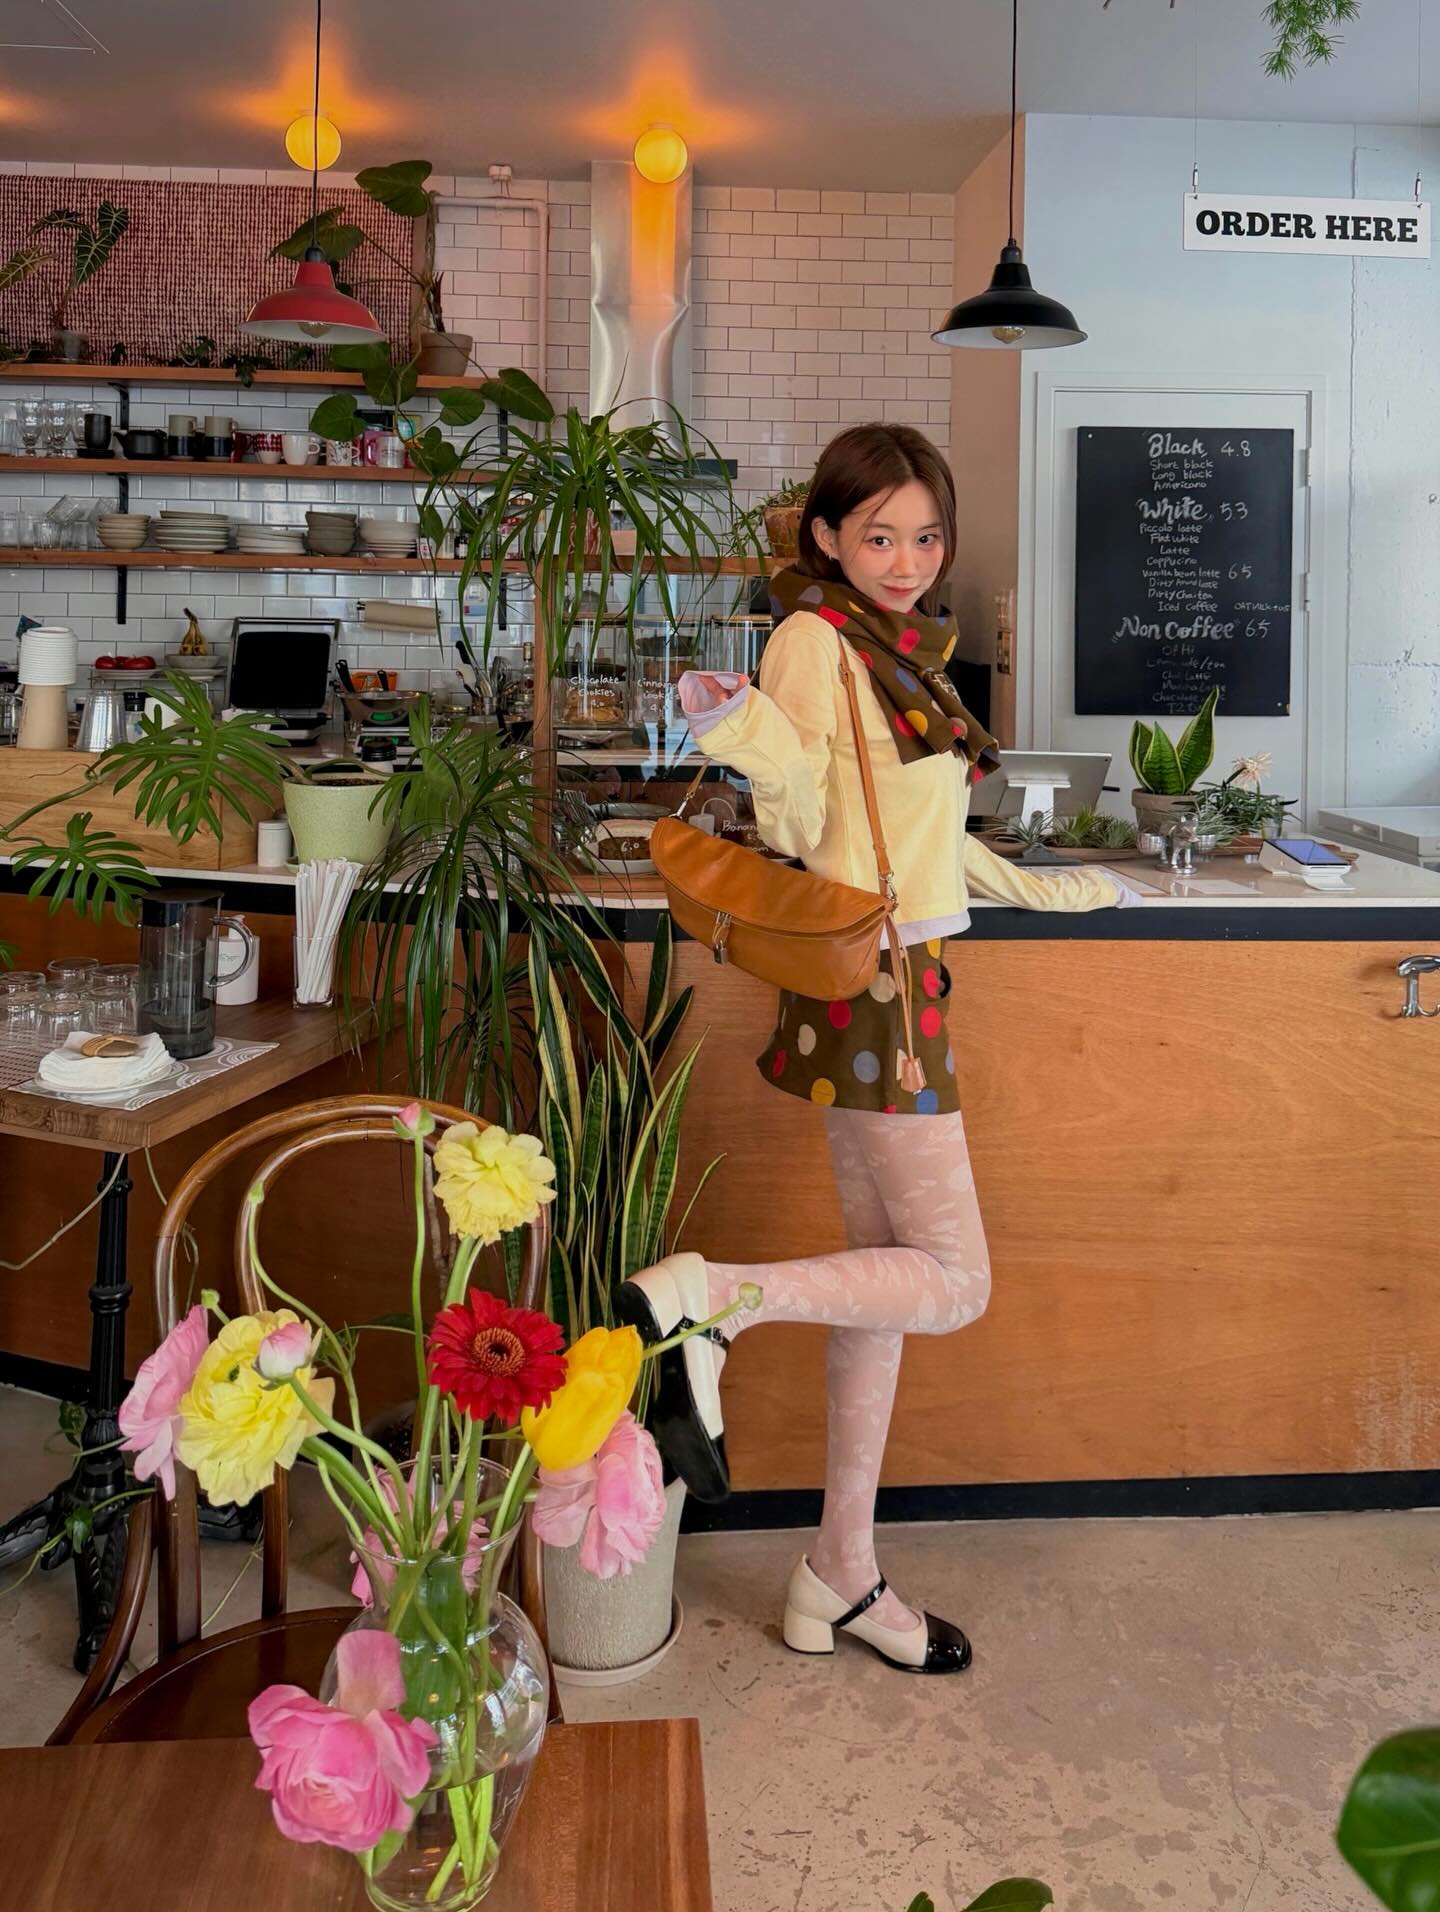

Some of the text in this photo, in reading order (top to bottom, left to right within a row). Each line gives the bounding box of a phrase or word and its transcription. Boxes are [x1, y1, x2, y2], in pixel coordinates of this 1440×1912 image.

[1195, 209, 1418, 243] ORDER HERE
[1220, 440, 1251, 457] 4.8
[1150, 458, 1214, 470] Short black
[1151, 469, 1213, 482] Long black
[1154, 481, 1207, 491] Americano
[1160, 545, 1191, 555] Latte
[569, 674, 620, 686] Chocolate
[637, 677, 679, 689] Cinnamo
